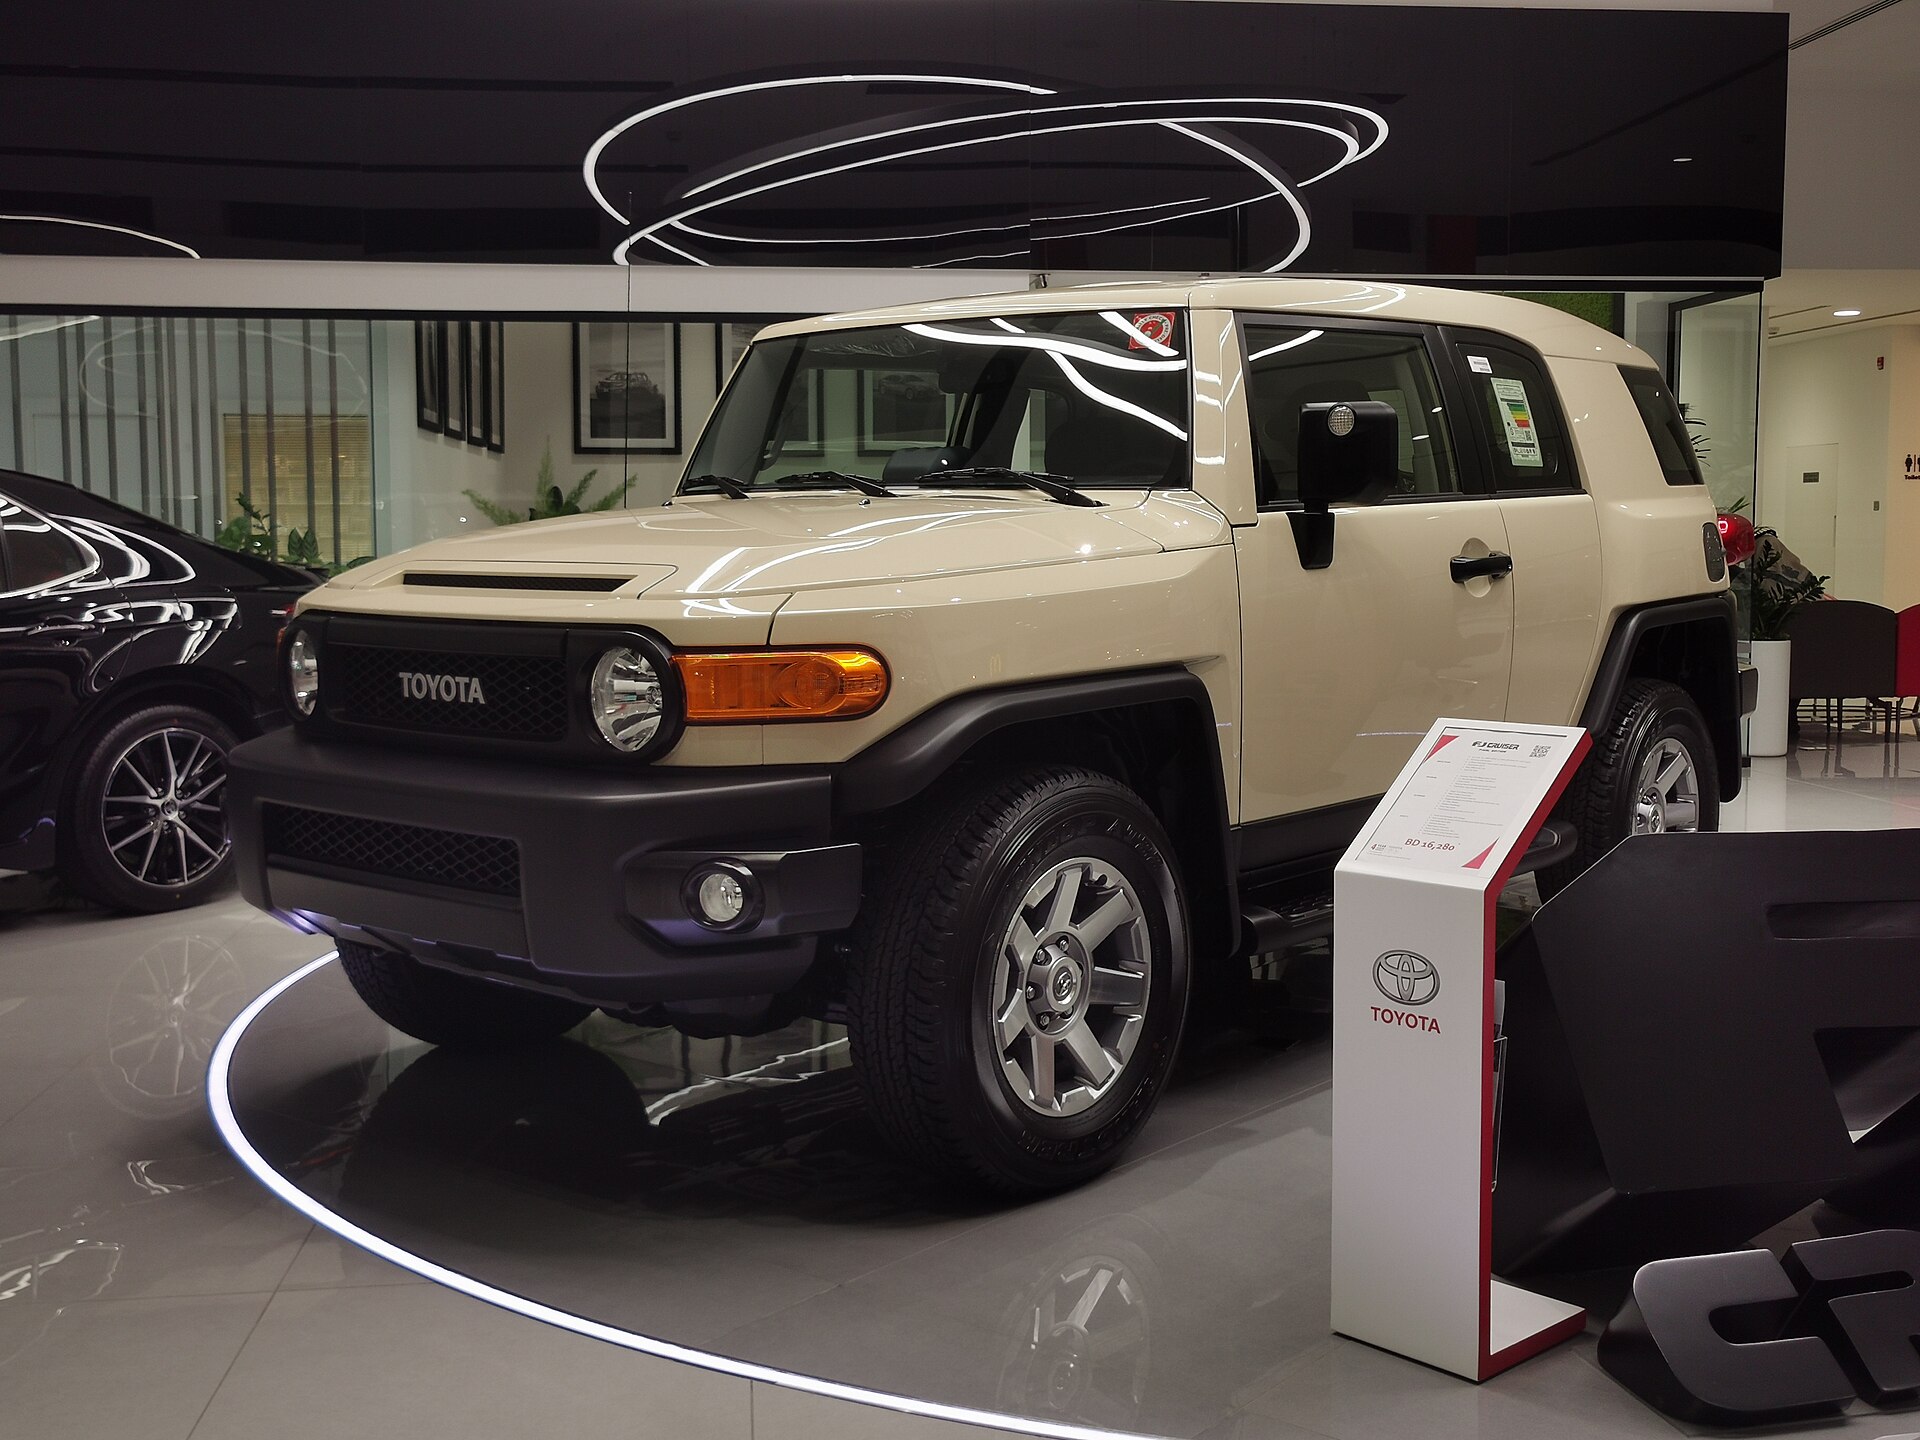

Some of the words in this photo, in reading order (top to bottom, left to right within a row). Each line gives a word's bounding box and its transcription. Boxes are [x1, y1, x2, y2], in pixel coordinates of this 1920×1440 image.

[398, 671, 486, 705] TOYOTA
[1487, 742, 1520, 750] CRUISER
[1404, 838, 1421, 847] BD
[1421, 841, 1455, 851] 16,280
[1370, 1006, 1441, 1034] TOYOTA
